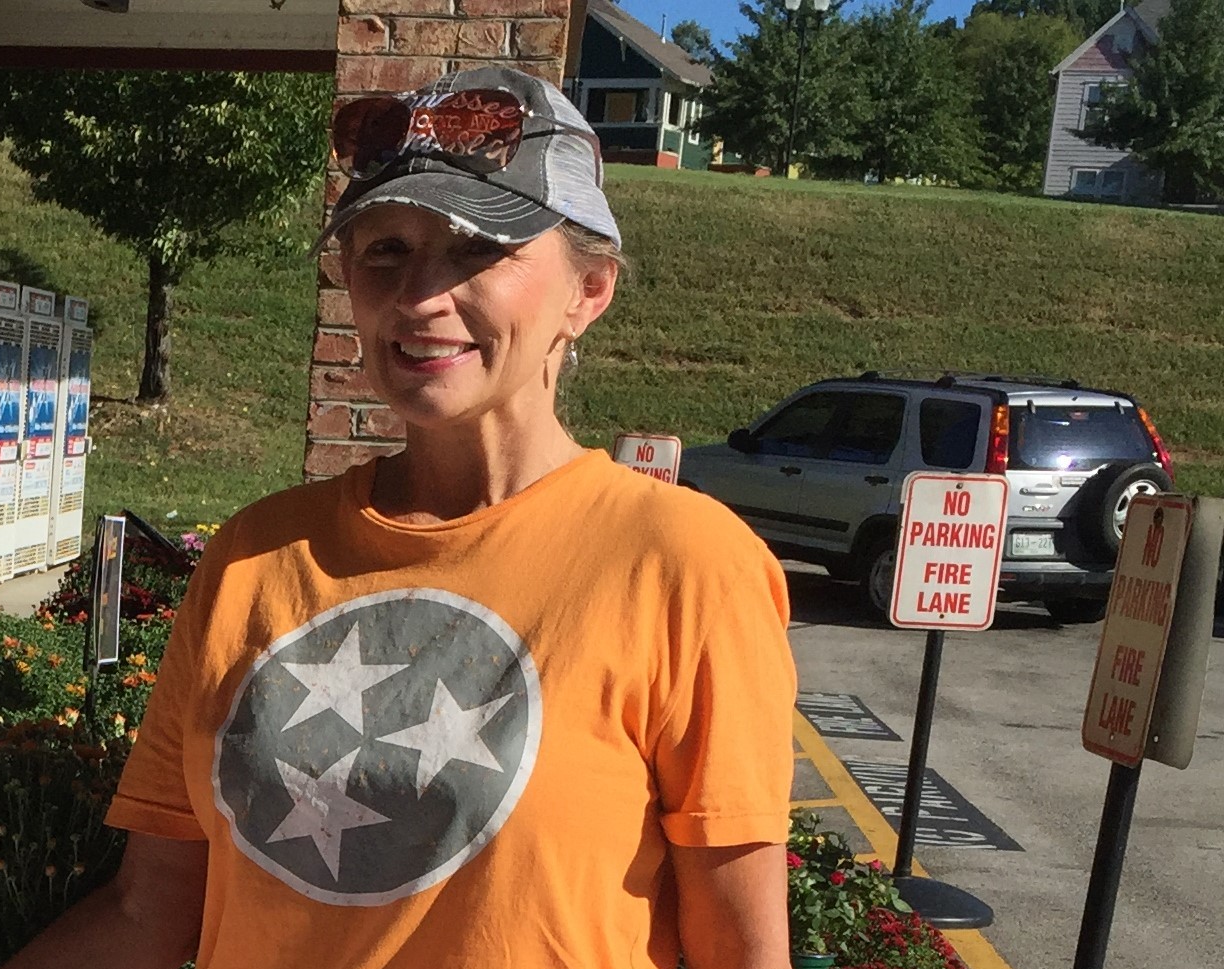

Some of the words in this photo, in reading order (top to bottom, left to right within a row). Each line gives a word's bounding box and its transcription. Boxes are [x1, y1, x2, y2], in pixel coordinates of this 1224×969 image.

[636, 445, 655, 463] NO
[943, 491, 971, 516] NO
[909, 521, 996, 549] PARKING
[1141, 523, 1165, 568] NO
[924, 562, 973, 585] FIRE
[916, 591, 972, 614] LANE
[1113, 574, 1172, 627] PARKING
[1110, 645, 1146, 688] FIRE
[1098, 692, 1137, 736] LANE
